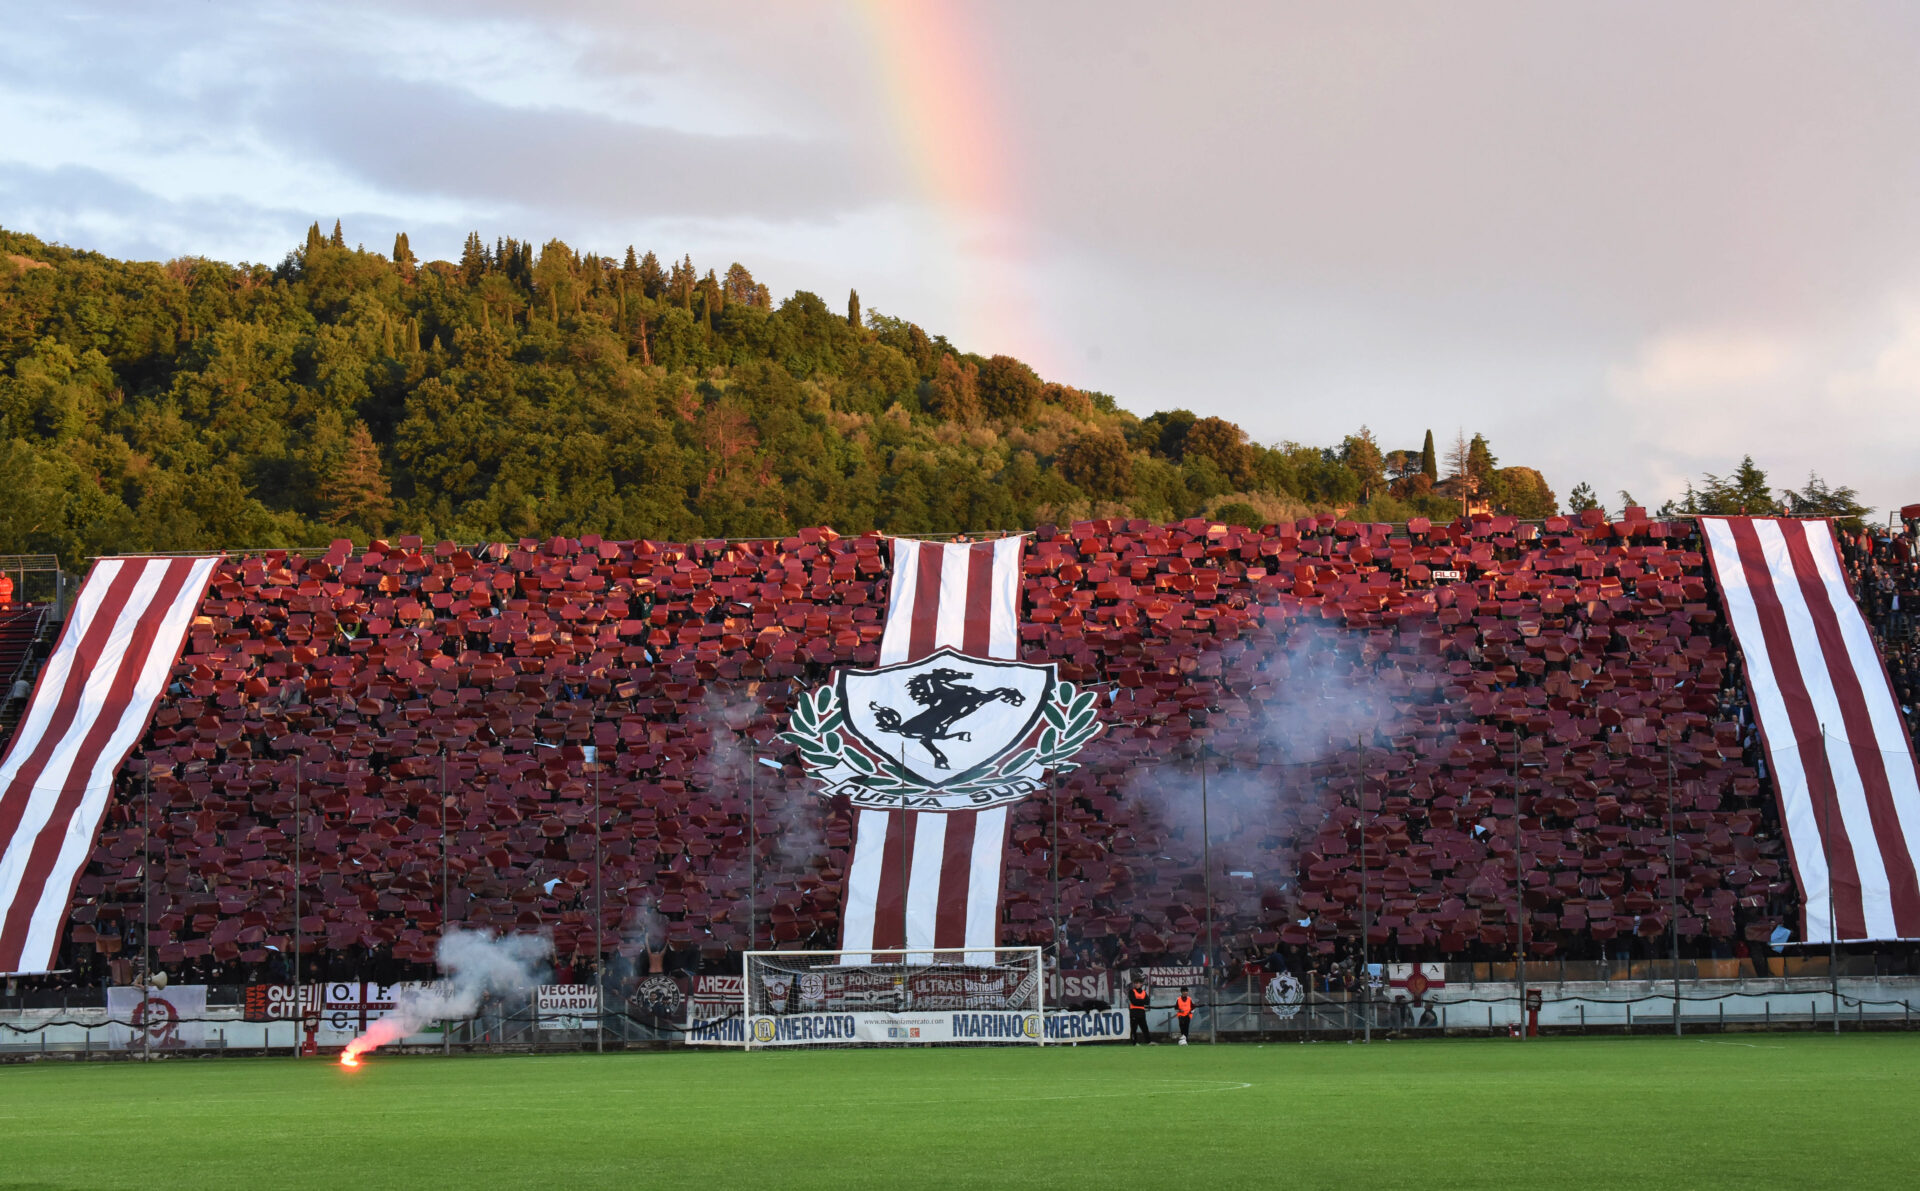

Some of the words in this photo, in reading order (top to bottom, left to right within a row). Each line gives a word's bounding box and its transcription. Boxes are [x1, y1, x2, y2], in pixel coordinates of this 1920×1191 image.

[836, 784, 942, 808] CURVA
[969, 781, 1037, 803] SUD
[1150, 966, 1204, 975] ASSENTI
[1429, 964, 1440, 974] A
[640, 977, 677, 994] AREZZO
[915, 979, 963, 993] ULTRAS
[964, 976, 1005, 992] CASTIGLION
[1041, 970, 1110, 1002] FOSSA
[1150, 975, 1205, 986] PRESENTI
[267, 984, 313, 1002] QUEI
[332, 983, 354, 1001] O.
[245, 986, 256, 1019] MAMA
[256, 984, 267, 1020] SANTA
[331, 1011, 353, 1029] C.
[775, 1015, 856, 1040] MERCATO
[952, 1014, 1023, 1037] MARINO
[1044, 1012, 1124, 1039] MERCATO
